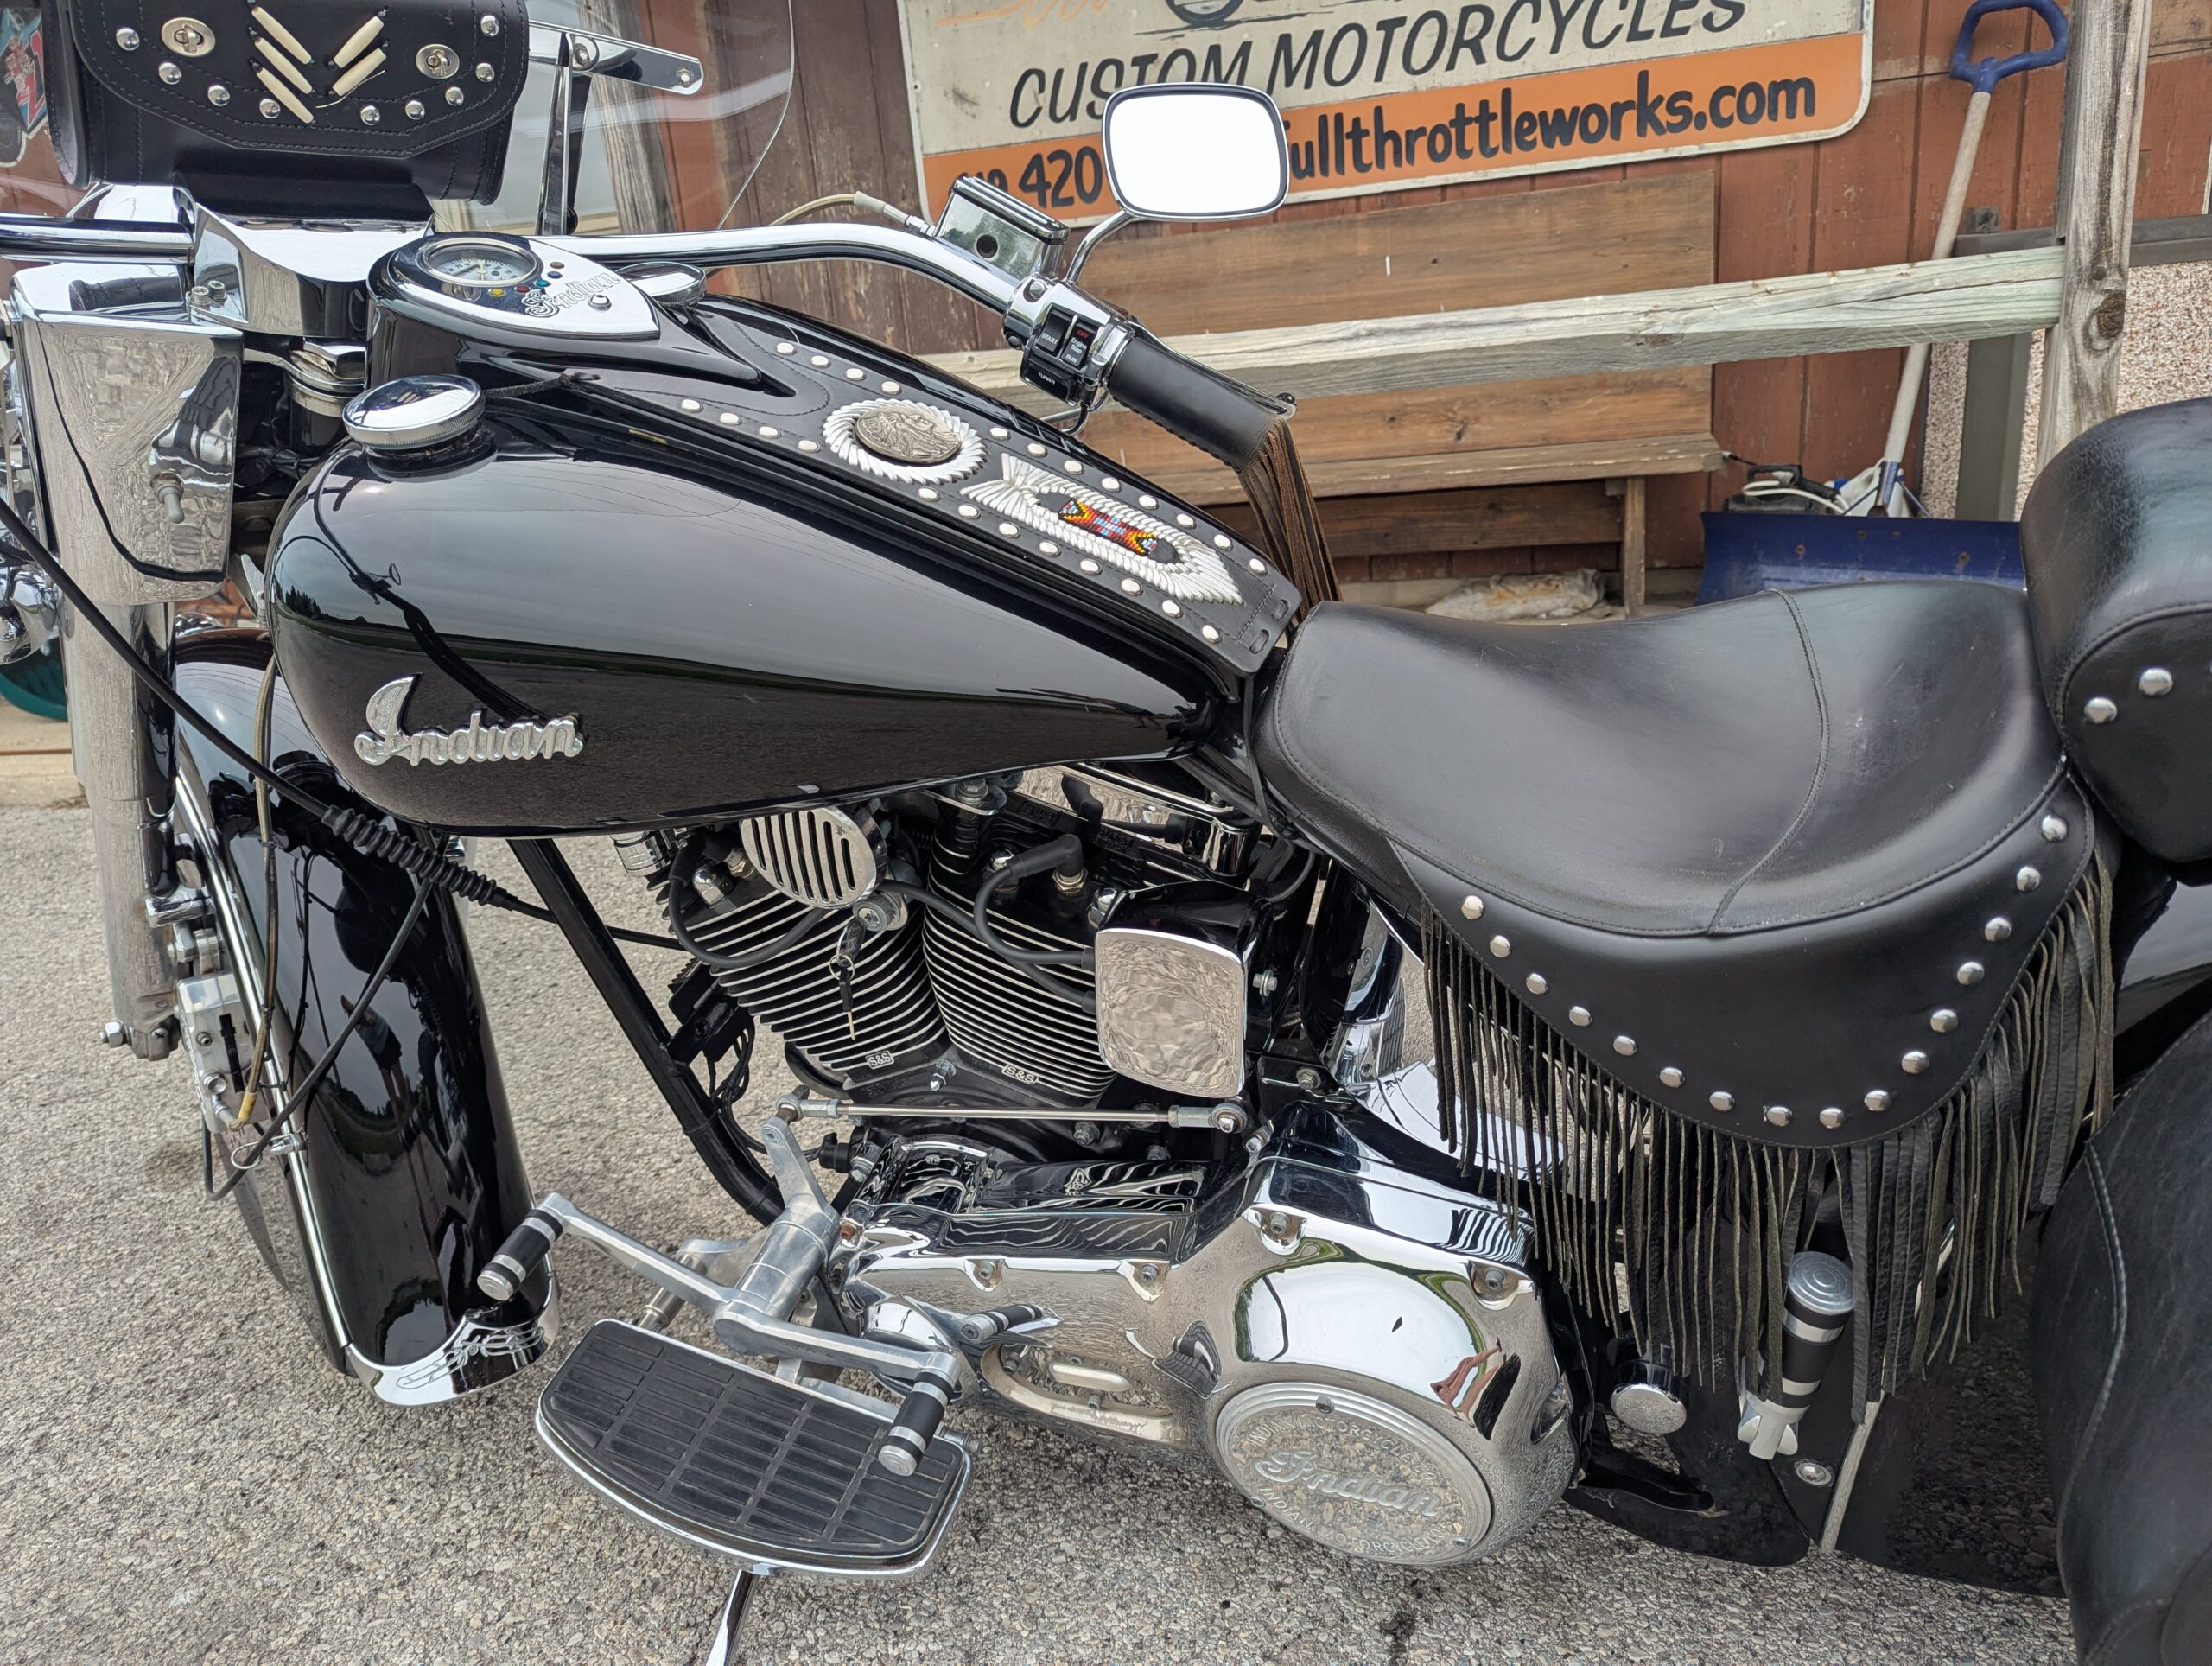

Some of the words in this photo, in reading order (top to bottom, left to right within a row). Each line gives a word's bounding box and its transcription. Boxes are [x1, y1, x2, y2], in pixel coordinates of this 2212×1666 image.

[1009, 41, 1253, 128] CUSTOM
[1266, 0, 1745, 95] MOTORCYCLES
[1018, 145, 1103, 209] 420
[521, 272, 621, 318] Indian
[1041, 333, 1058, 345] START
[1065, 354, 1077, 363] RUN
[1070, 344, 1083, 354] Stop
[1071, 337, 1087, 350] Engine
[353, 671, 586, 767] Indian
[868, 1052, 893, 1067] S&S
[1006, 1065, 1035, 1083] S&S
[1246, 1415, 1294, 1447] INDIAN
[1297, 1415, 1417, 1464] MOTORCYCLE
[1253, 1449, 1441, 1517] Indian
[1258, 1487, 1313, 1527] INDIAN
[1319, 1528, 1428, 1553] MOTORCYCLE
